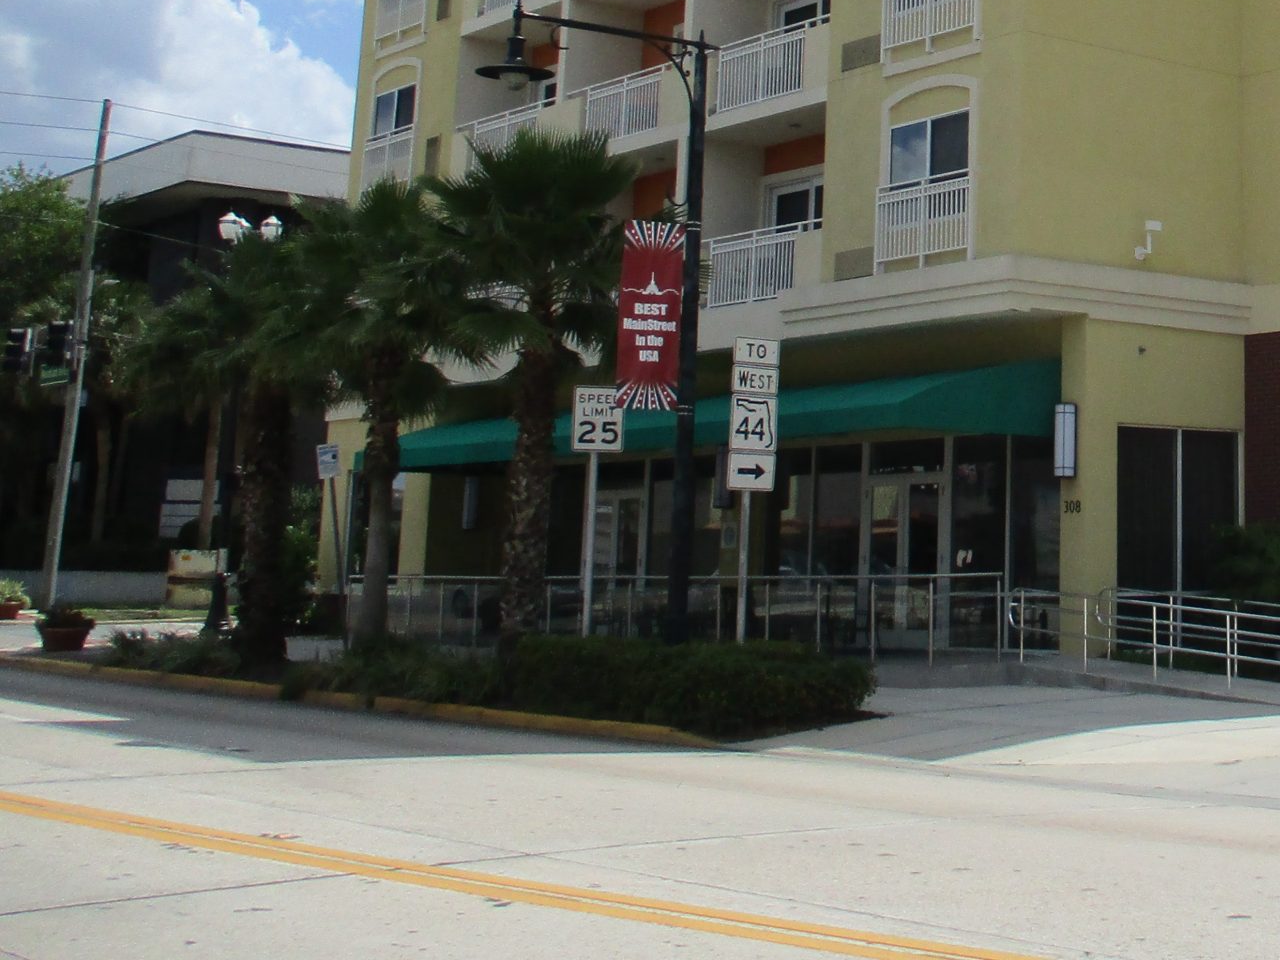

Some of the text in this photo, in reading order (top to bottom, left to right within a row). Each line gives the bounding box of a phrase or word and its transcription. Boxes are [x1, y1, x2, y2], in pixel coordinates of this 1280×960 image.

[634, 302, 668, 316] BEST
[647, 334, 664, 347] the
[639, 350, 659, 362] USA
[746, 342, 767, 359] TO
[739, 370, 773, 390] WEST
[582, 406, 615, 417] LIMIT
[578, 420, 618, 445] 25
[735, 416, 765, 441] 44
[1063, 500, 1081, 514] 308
